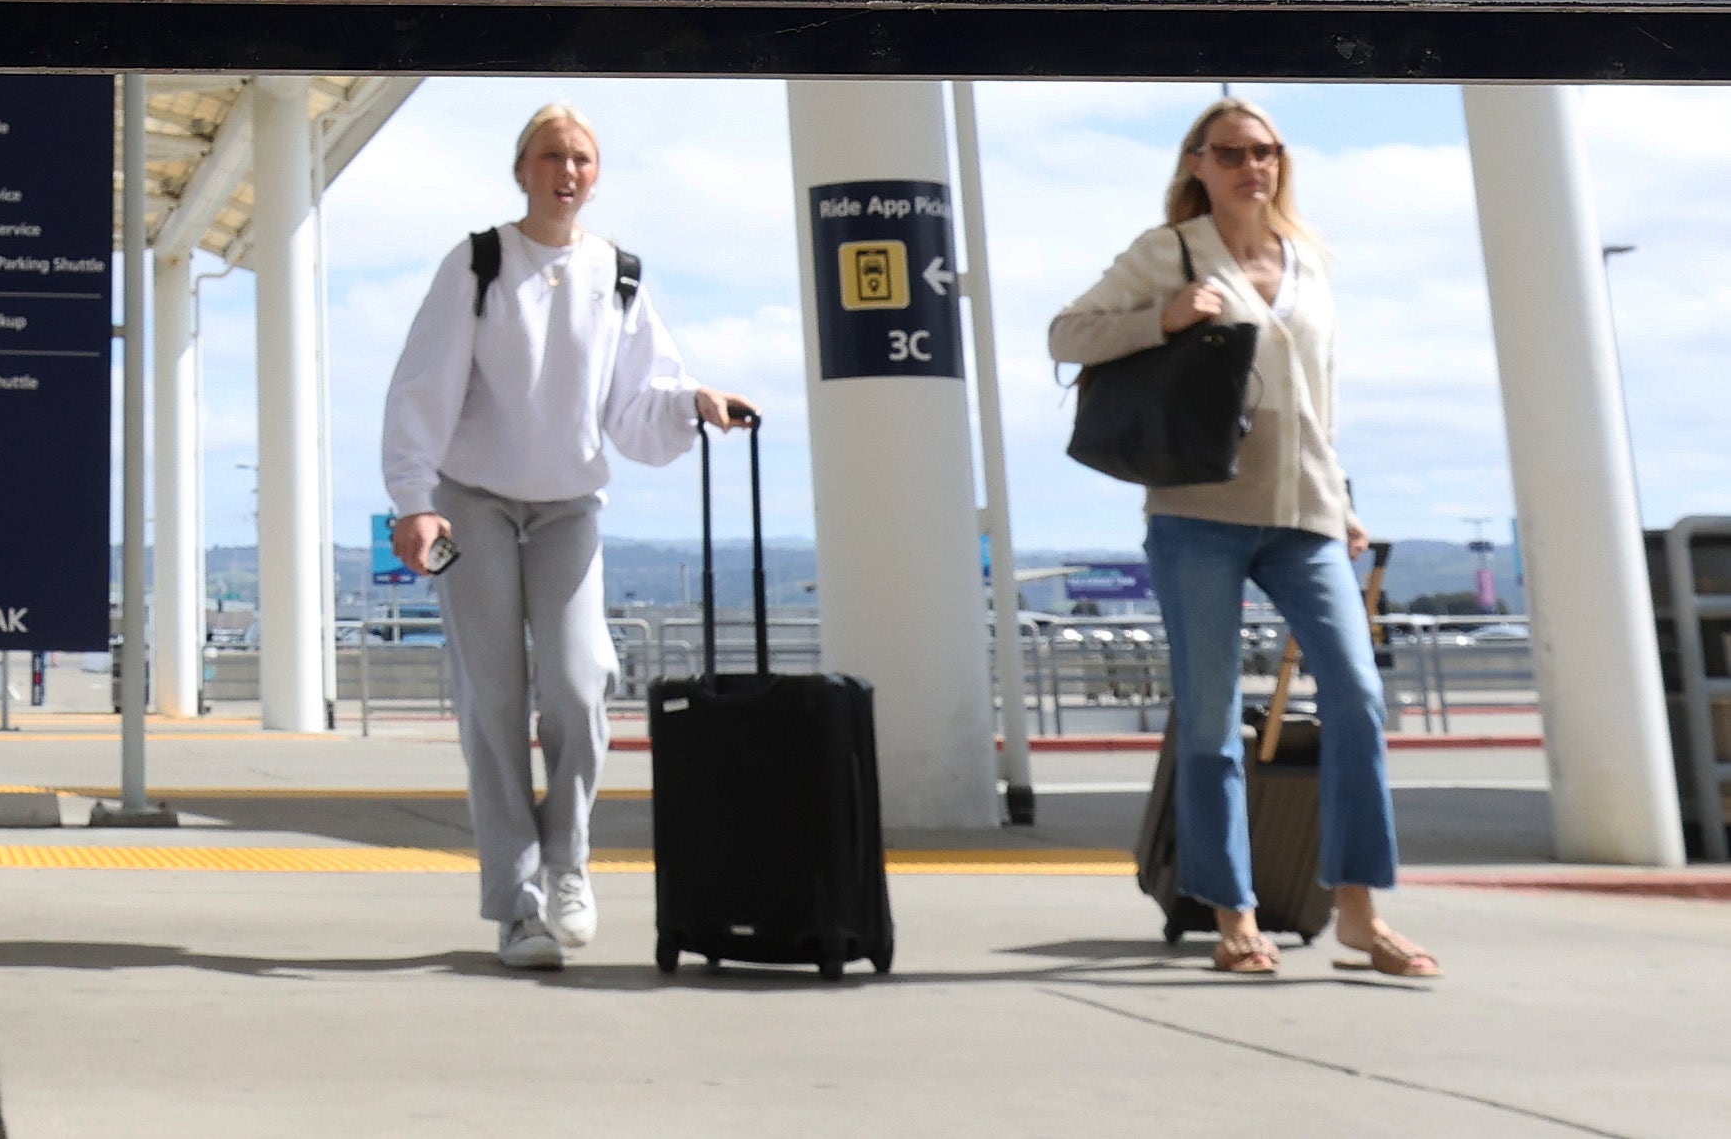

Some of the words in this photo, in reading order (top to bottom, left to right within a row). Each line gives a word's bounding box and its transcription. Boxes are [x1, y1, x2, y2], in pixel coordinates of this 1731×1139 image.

[820, 197, 862, 218] Ride
[867, 195, 911, 220] App
[52, 256, 106, 273] Shuttle
[887, 328, 933, 362] 3C
